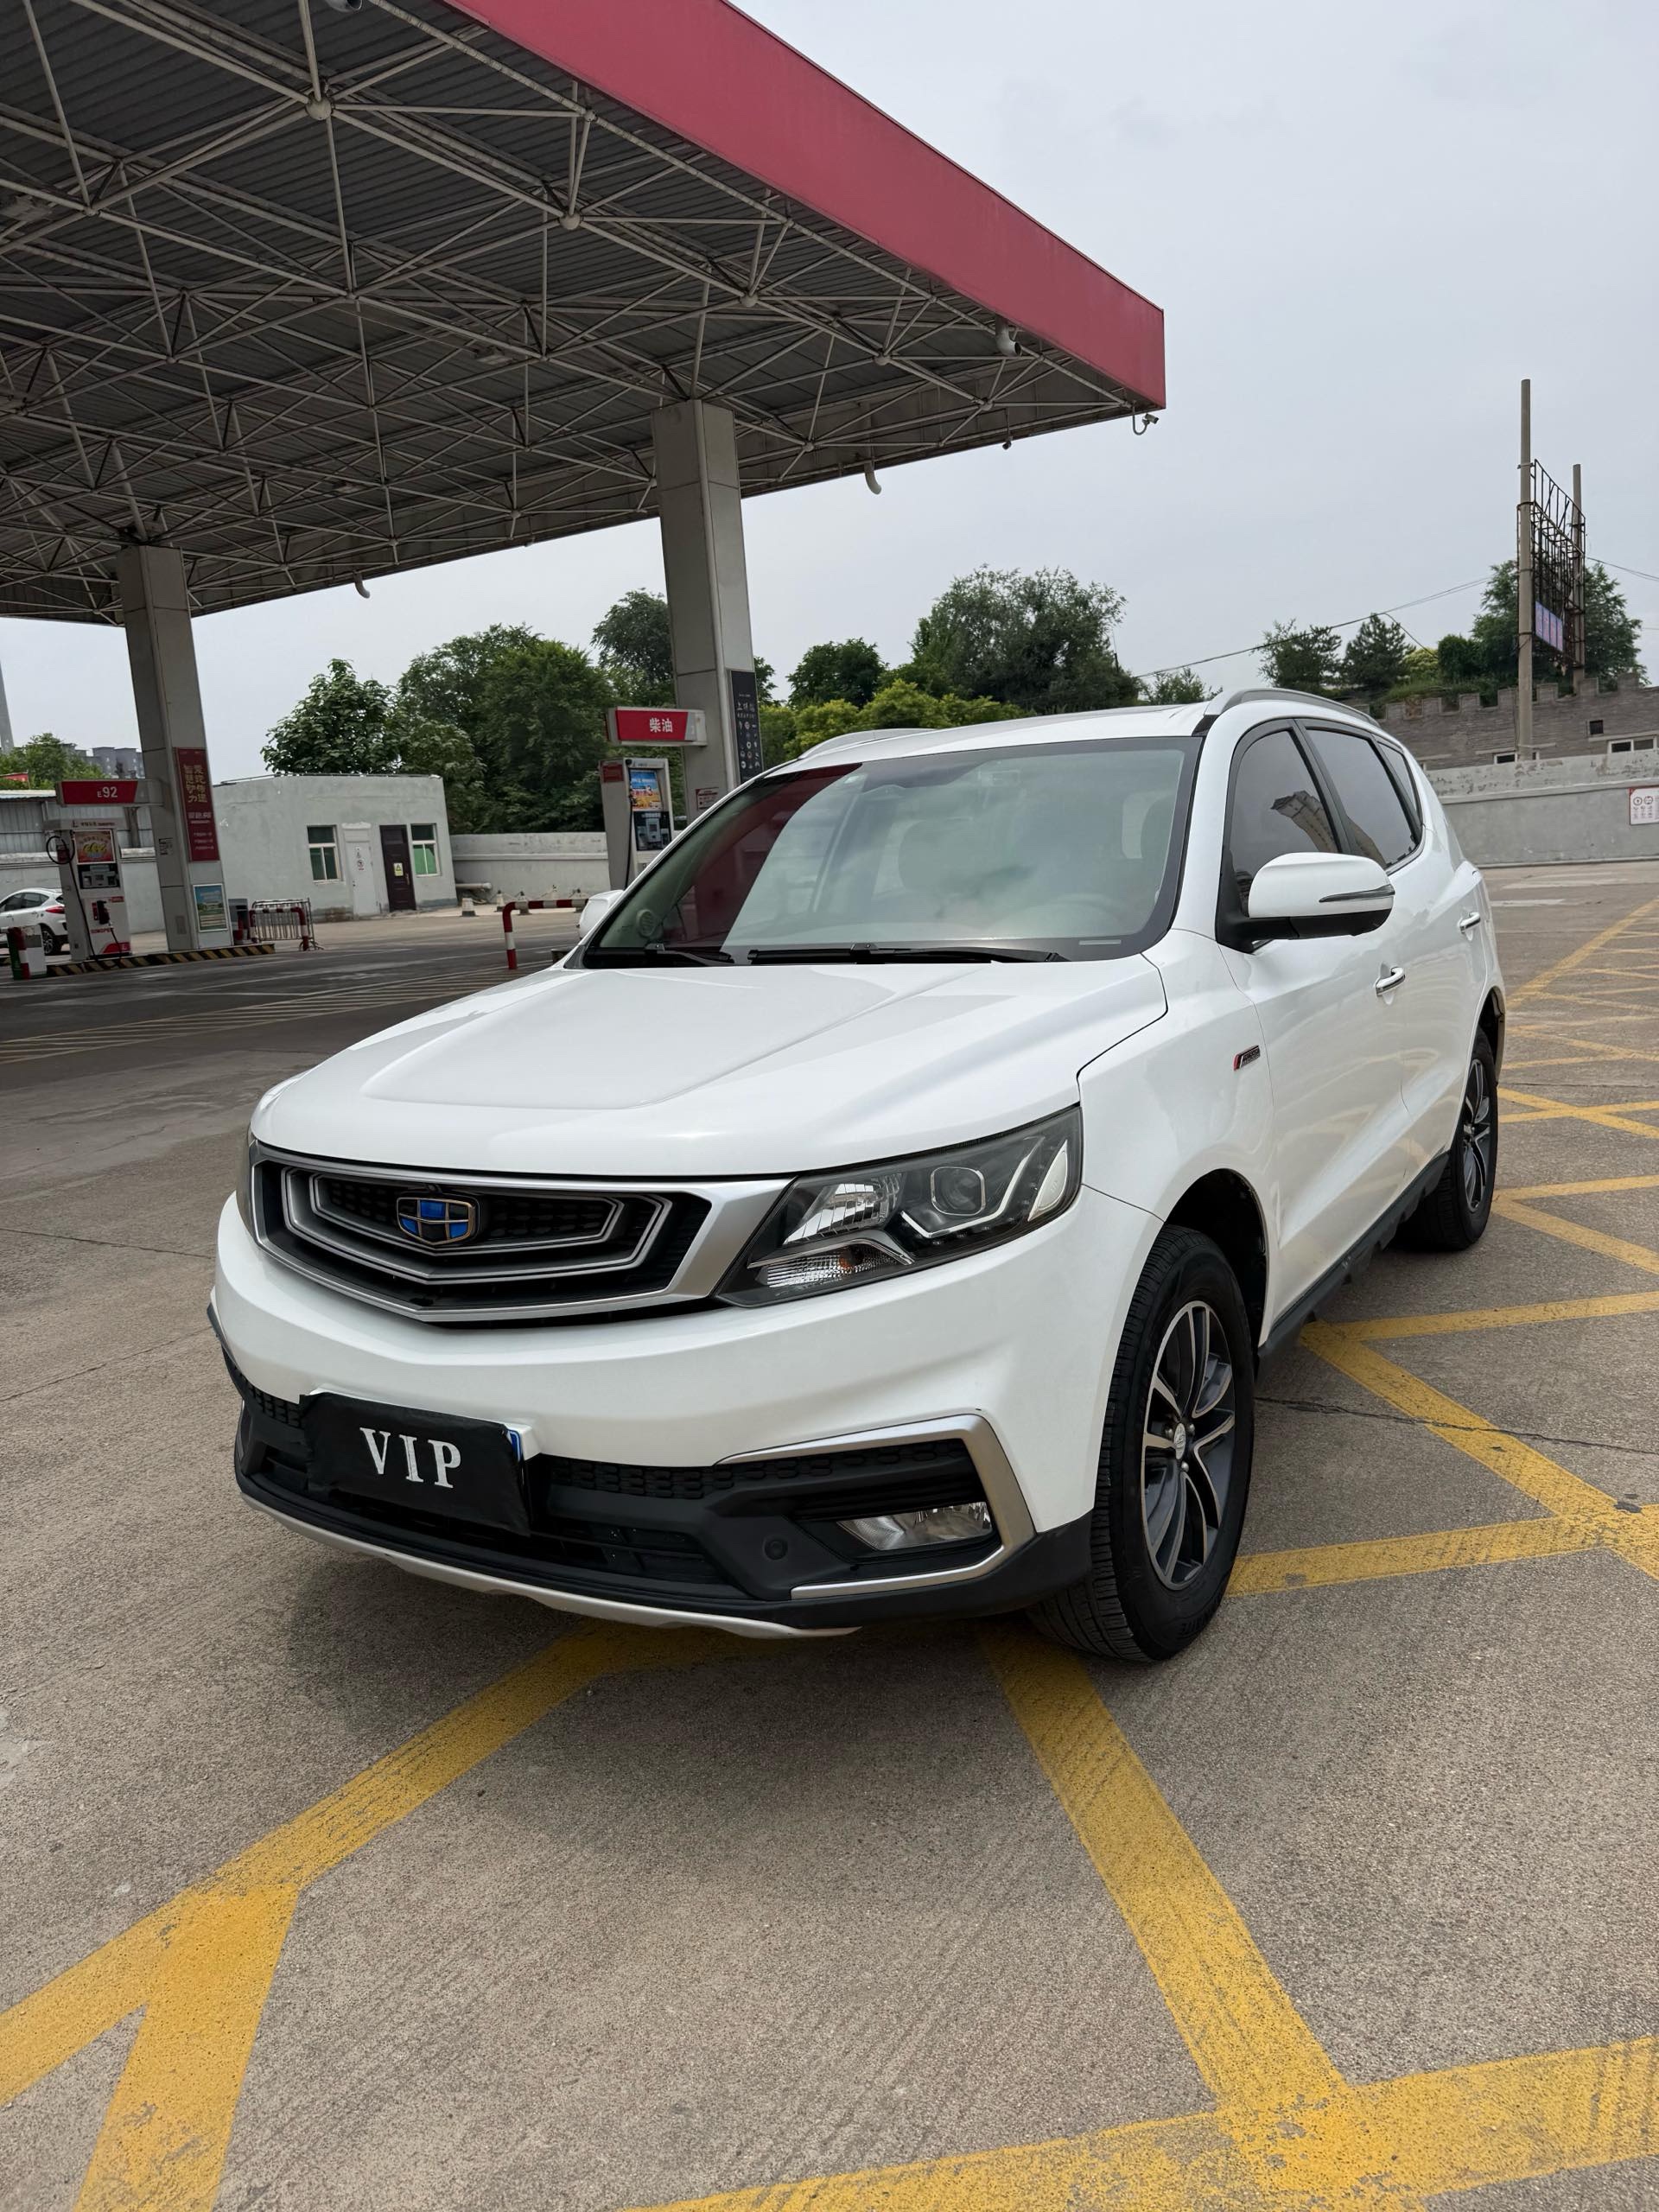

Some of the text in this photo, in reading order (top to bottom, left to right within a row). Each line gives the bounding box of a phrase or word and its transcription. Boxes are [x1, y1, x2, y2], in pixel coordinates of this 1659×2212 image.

[649, 717, 672, 733] 柴油
[97, 786, 118, 798] E92
[359, 1427, 461, 1488] VIP
